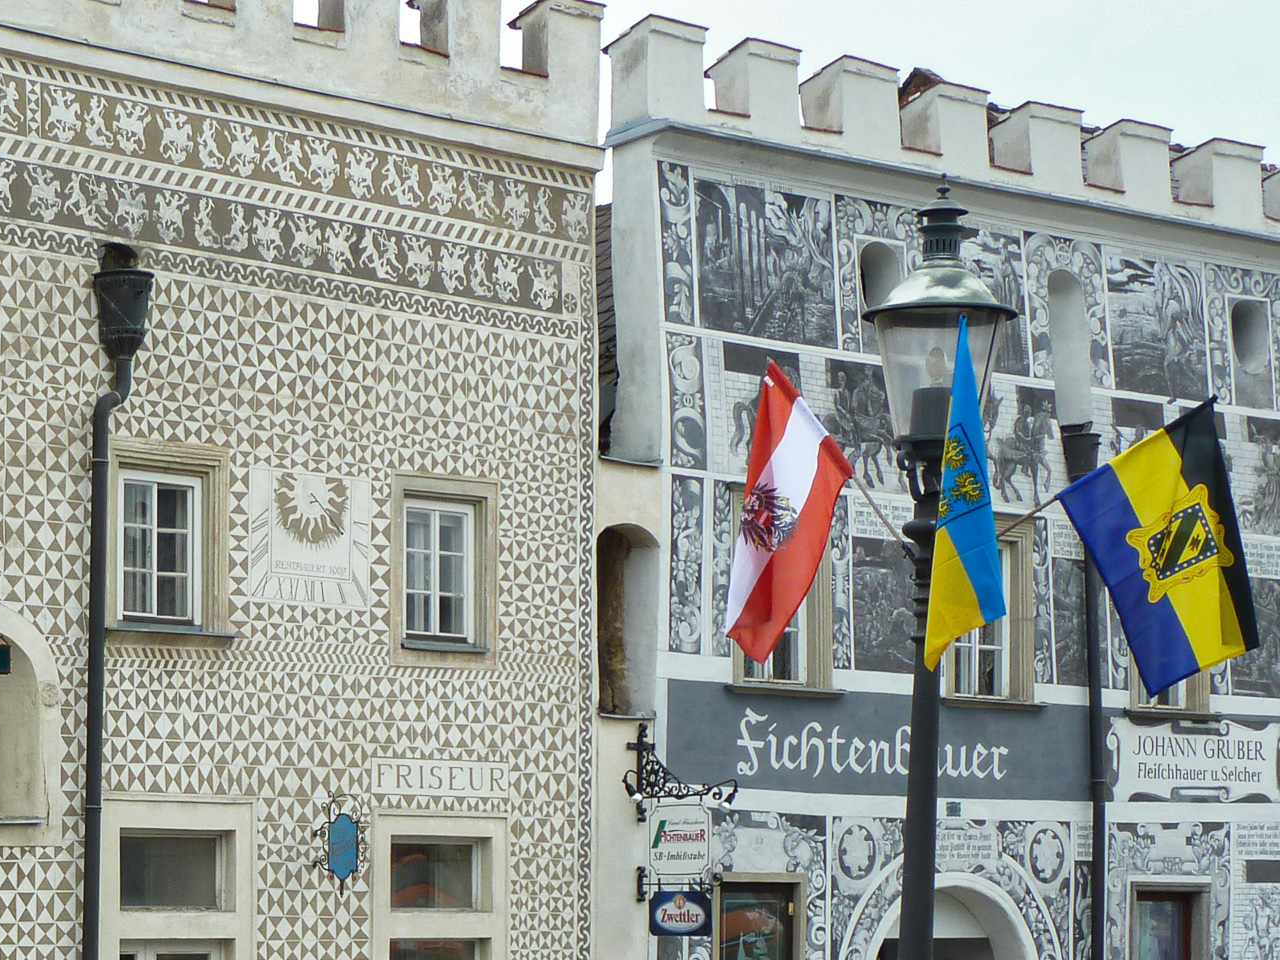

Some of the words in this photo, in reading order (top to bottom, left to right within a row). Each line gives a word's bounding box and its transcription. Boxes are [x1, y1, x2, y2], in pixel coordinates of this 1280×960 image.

[736, 707, 1009, 780] Fichtenbuer
[1132, 735, 1197, 758] JOHANN
[1203, 738, 1267, 761] GRUBER
[376, 763, 507, 792] FRISEUR
[1221, 765, 1262, 783] Selcher
[660, 908, 700, 923] Zwettler
